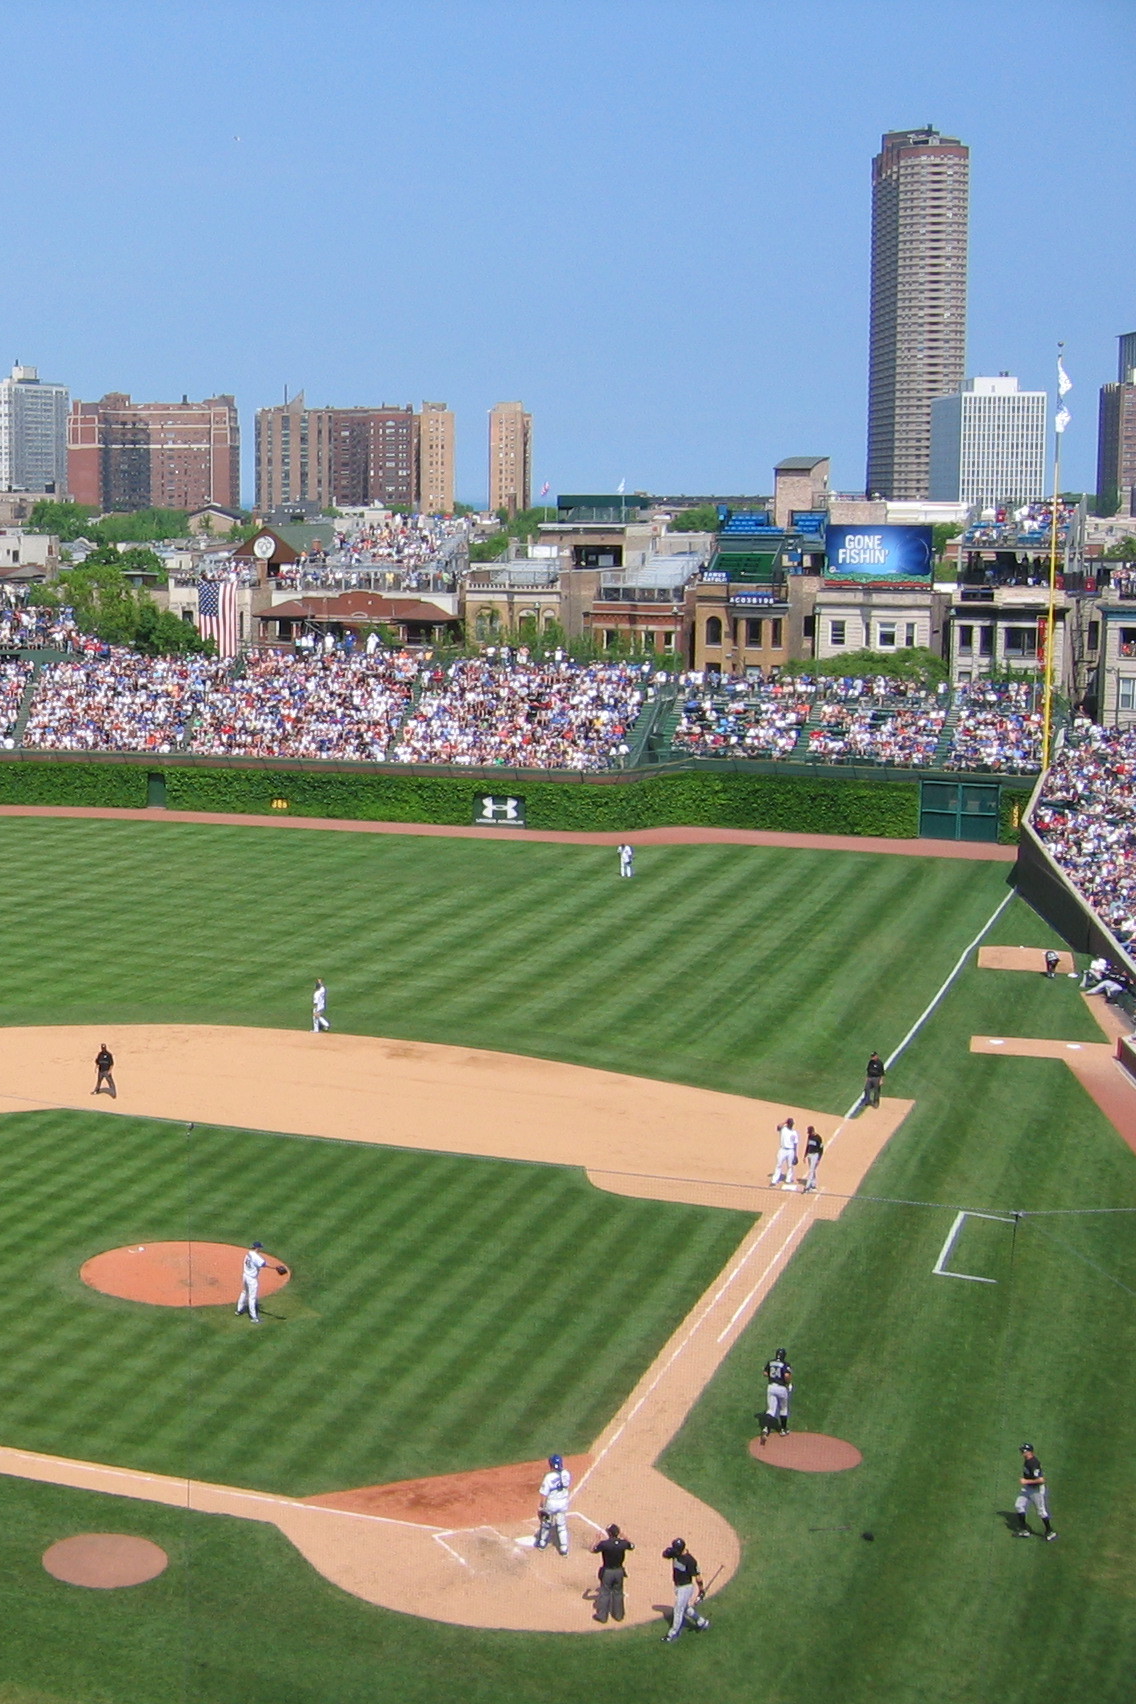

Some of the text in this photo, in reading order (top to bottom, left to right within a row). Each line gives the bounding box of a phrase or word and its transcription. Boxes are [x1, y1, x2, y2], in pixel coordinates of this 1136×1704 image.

[845, 535, 882, 549] GONE
[838, 549, 889, 564] FISHIN'
[770, 1366, 782, 1378] 24
